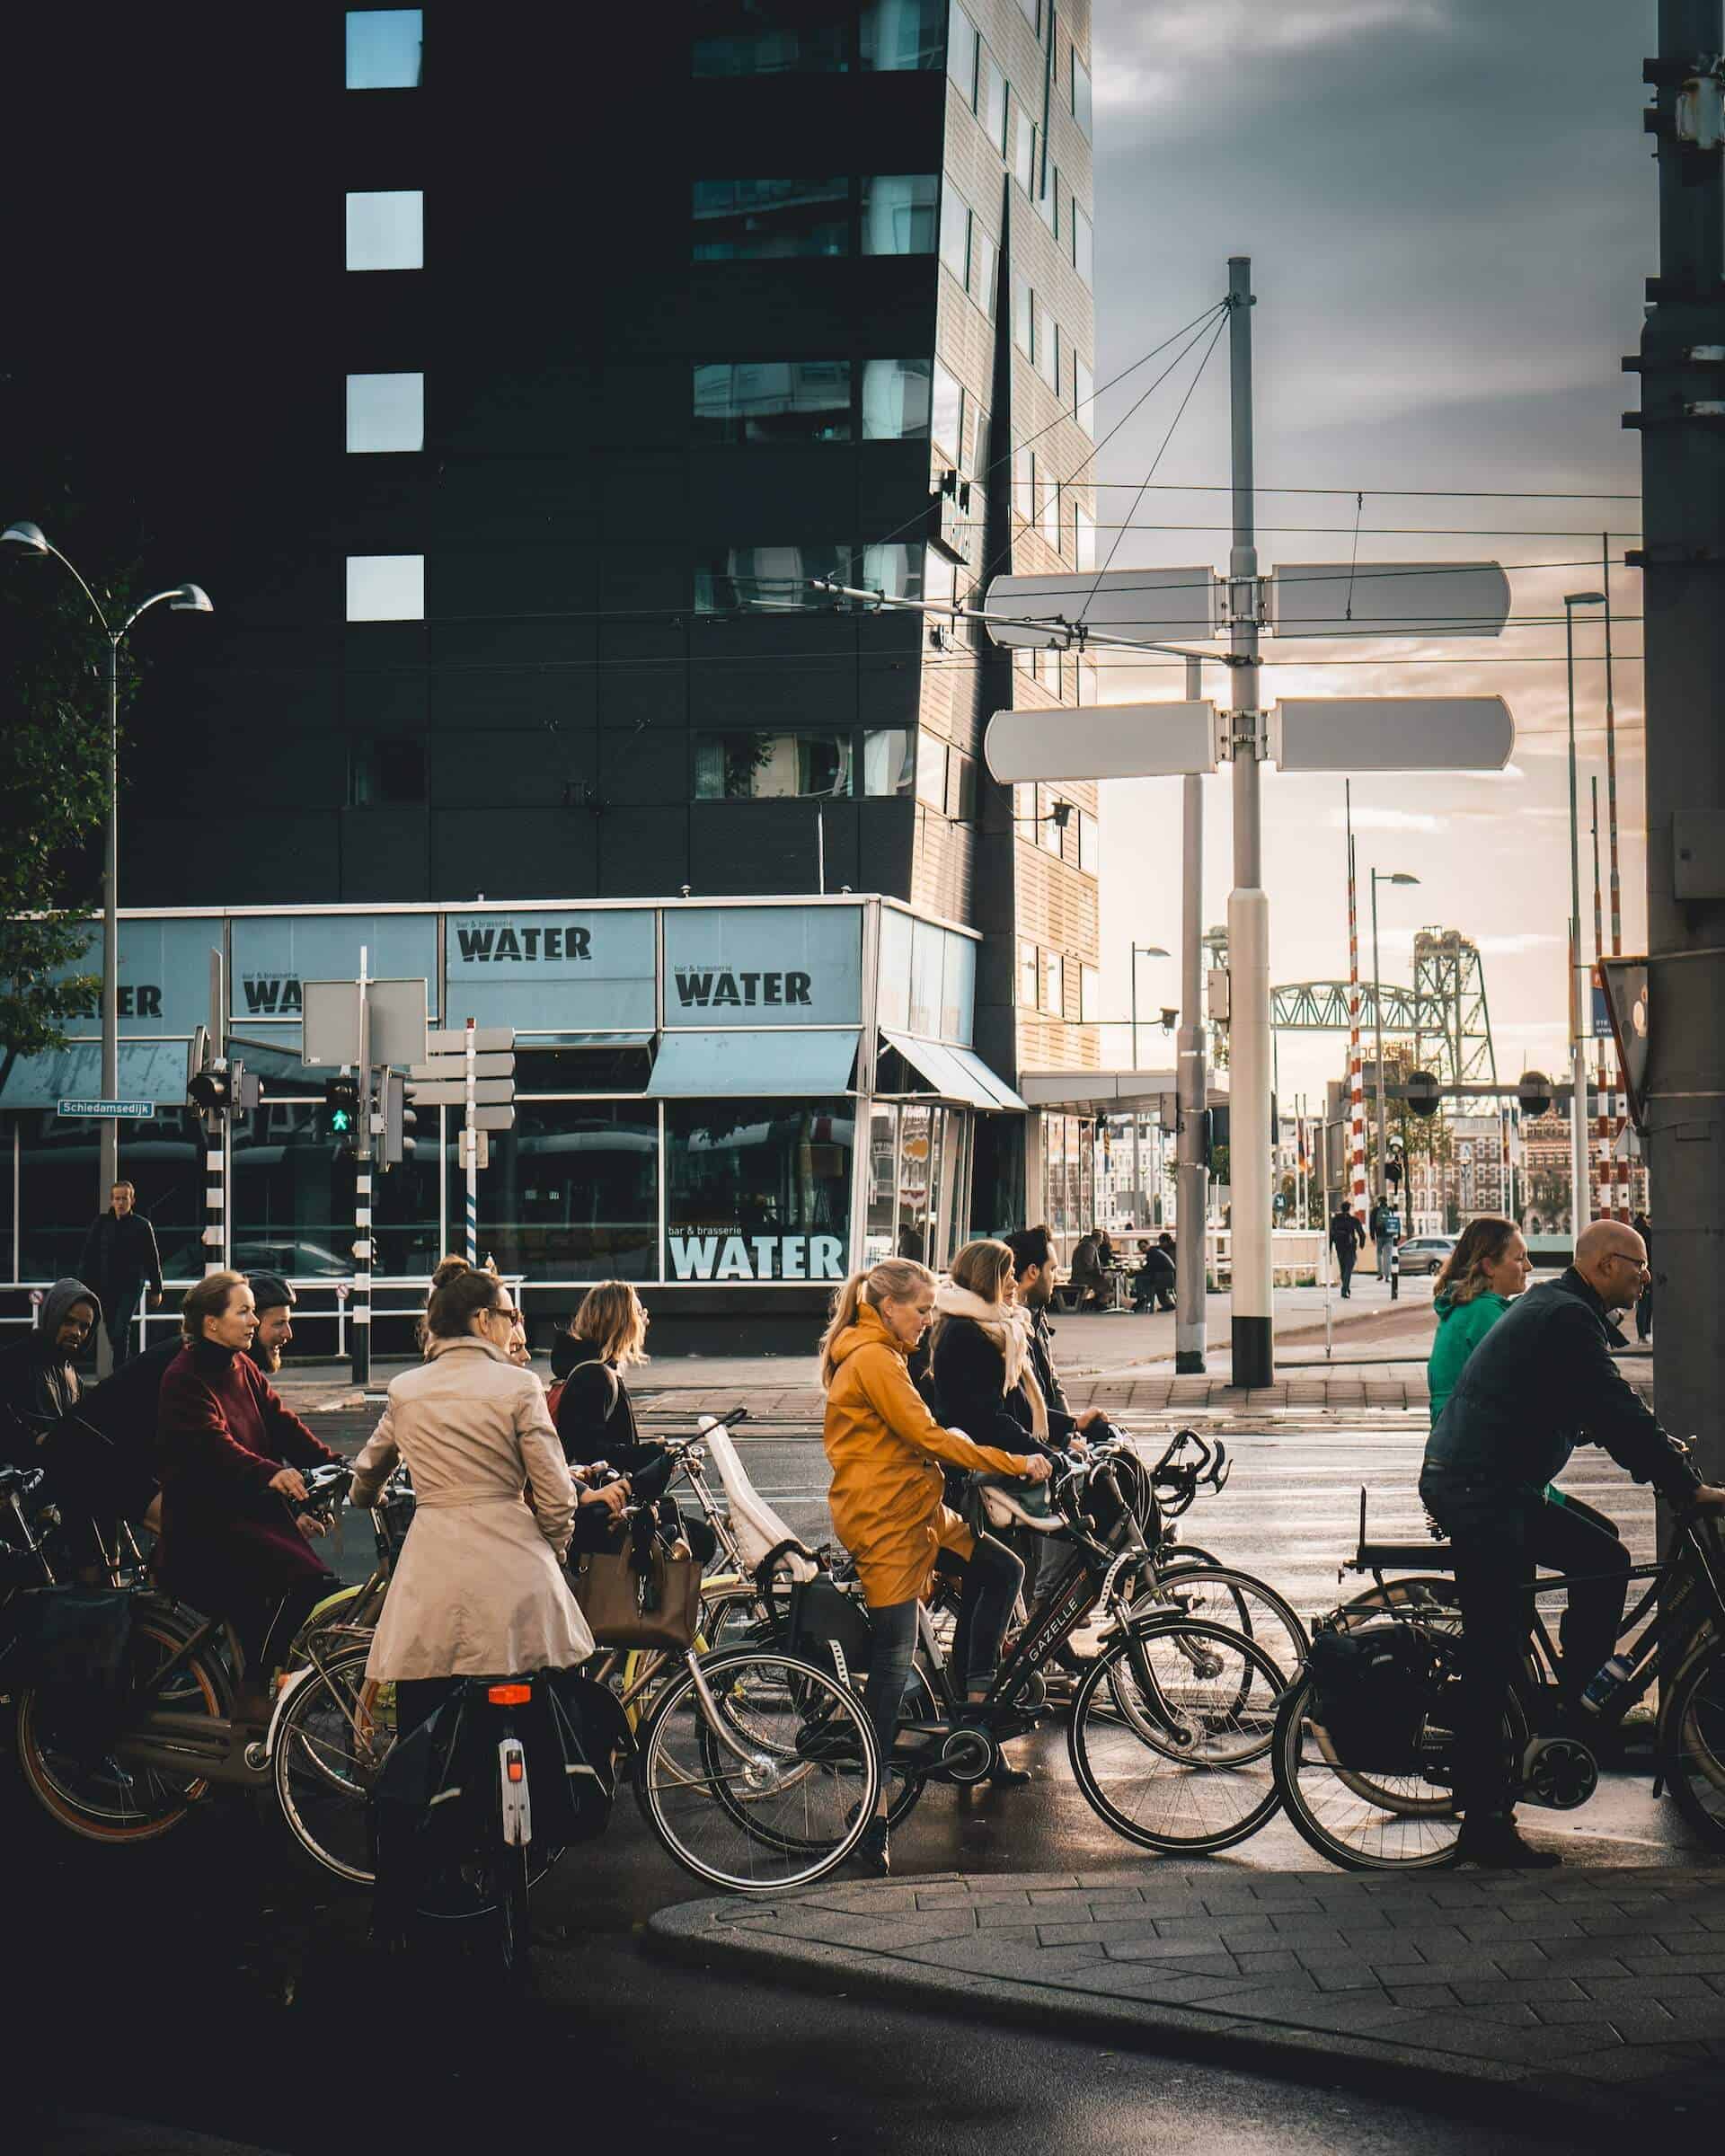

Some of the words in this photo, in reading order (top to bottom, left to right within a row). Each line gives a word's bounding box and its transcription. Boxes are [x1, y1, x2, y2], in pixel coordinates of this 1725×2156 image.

[457, 927, 592, 962] WATER
[243, 980, 303, 1013] WA
[675, 972, 812, 1006] WATER
[64, 1102, 148, 1116] Schiedamsedijk
[668, 1225, 685, 1236] bar
[686, 1226, 694, 1236] &
[697, 1225, 741, 1236] brasserie
[668, 1235, 844, 1279] WATER
[1029, 1597, 1078, 1662] GAZELLE
